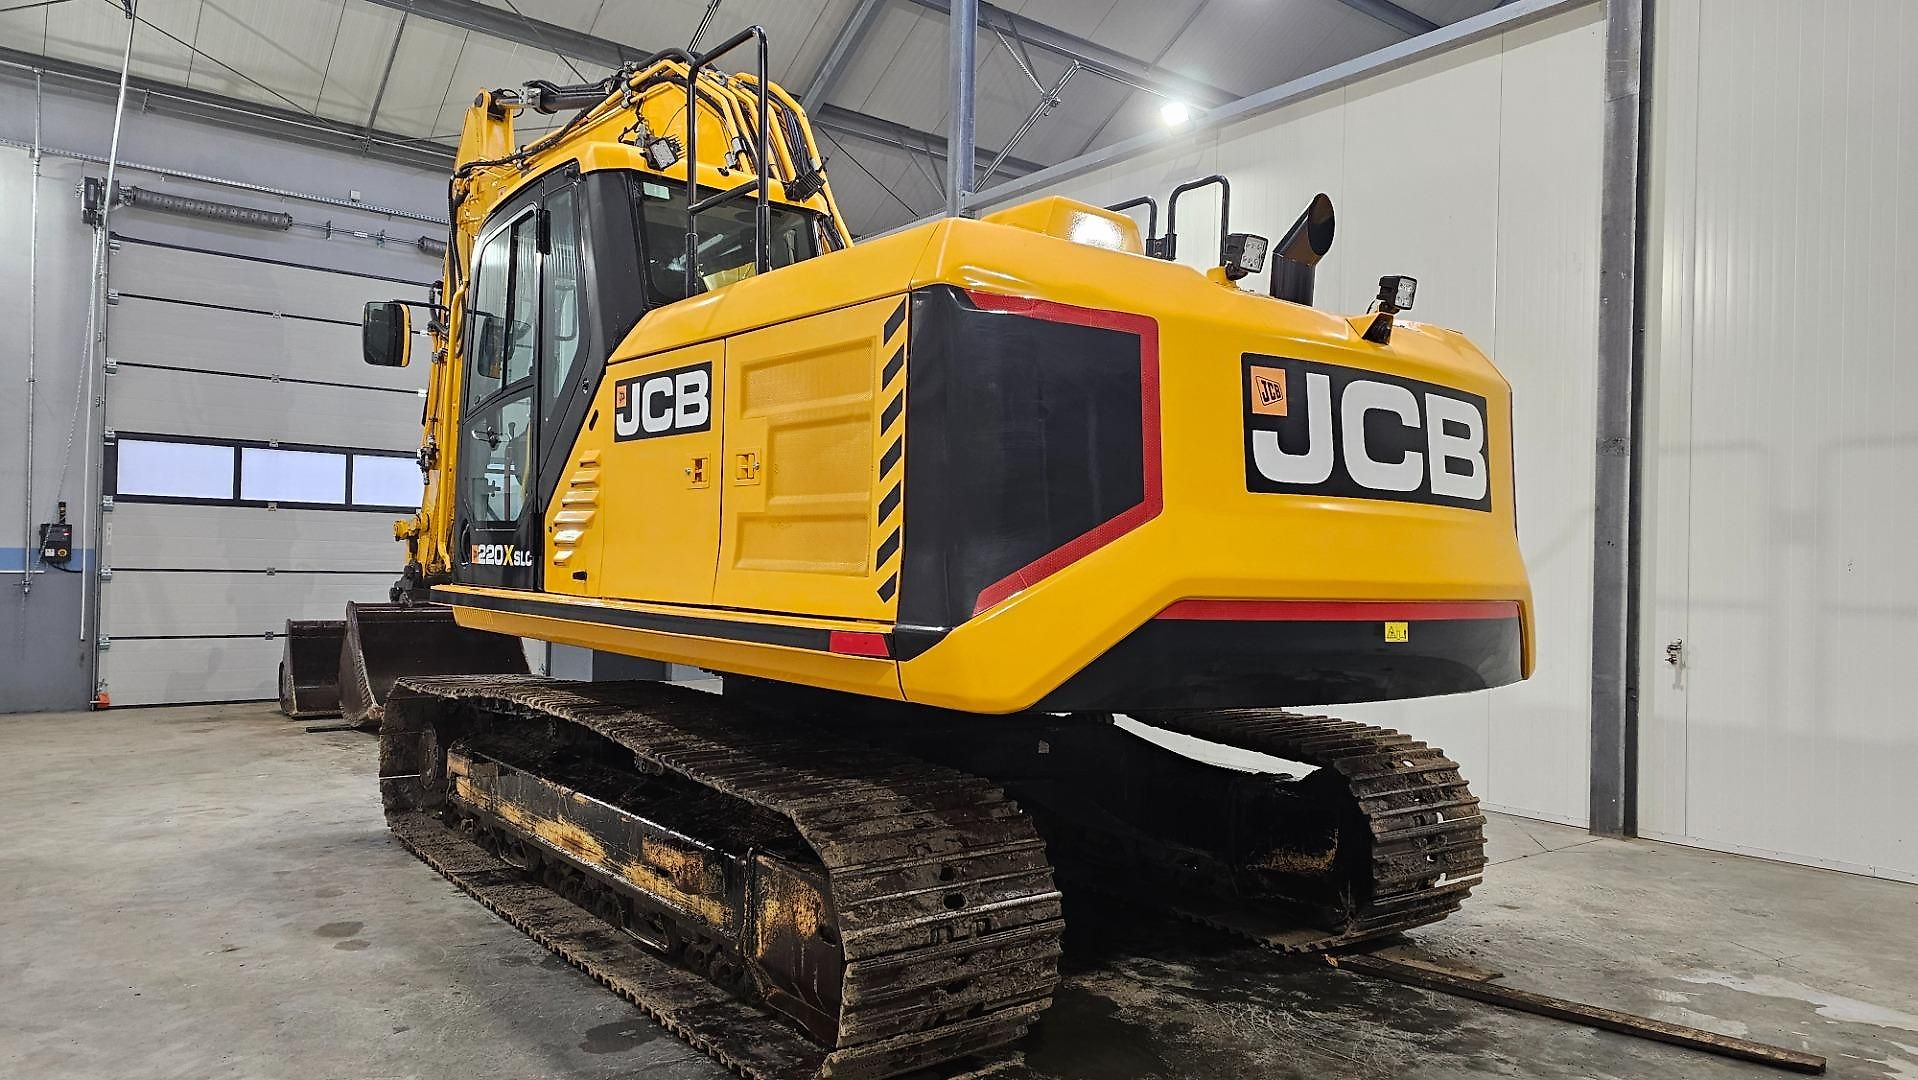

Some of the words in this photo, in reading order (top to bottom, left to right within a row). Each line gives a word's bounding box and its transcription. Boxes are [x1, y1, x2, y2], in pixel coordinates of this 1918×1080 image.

[616, 369, 709, 436] JCB
[1260, 379, 1281, 402] JCB
[1252, 372, 1487, 501] JCB
